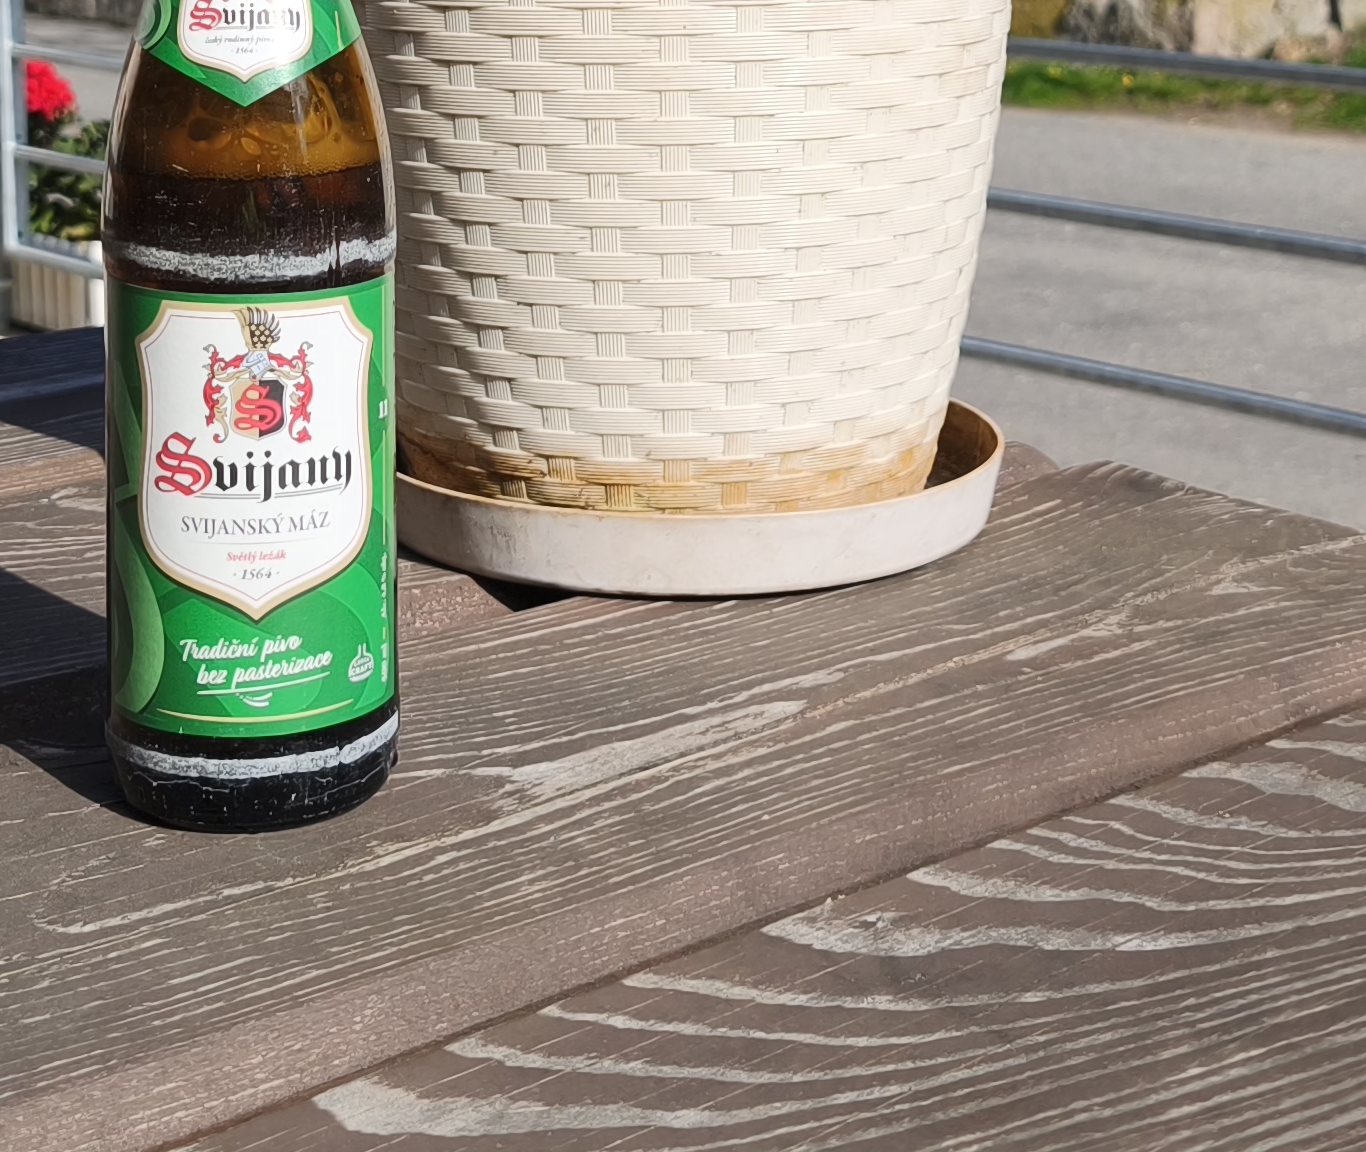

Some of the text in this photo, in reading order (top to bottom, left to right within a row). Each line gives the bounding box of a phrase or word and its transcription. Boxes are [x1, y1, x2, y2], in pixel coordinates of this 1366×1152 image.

[154, 431, 352, 504] Svijany
[180, 509, 331, 540] SVIJANSKÝ MÁZ
[226, 549, 287, 564] Světlý ležák
[241, 567, 273, 581] 1564
[179, 635, 303, 663] Tradiční pivo
[196, 651, 333, 690] bez pasterizace
